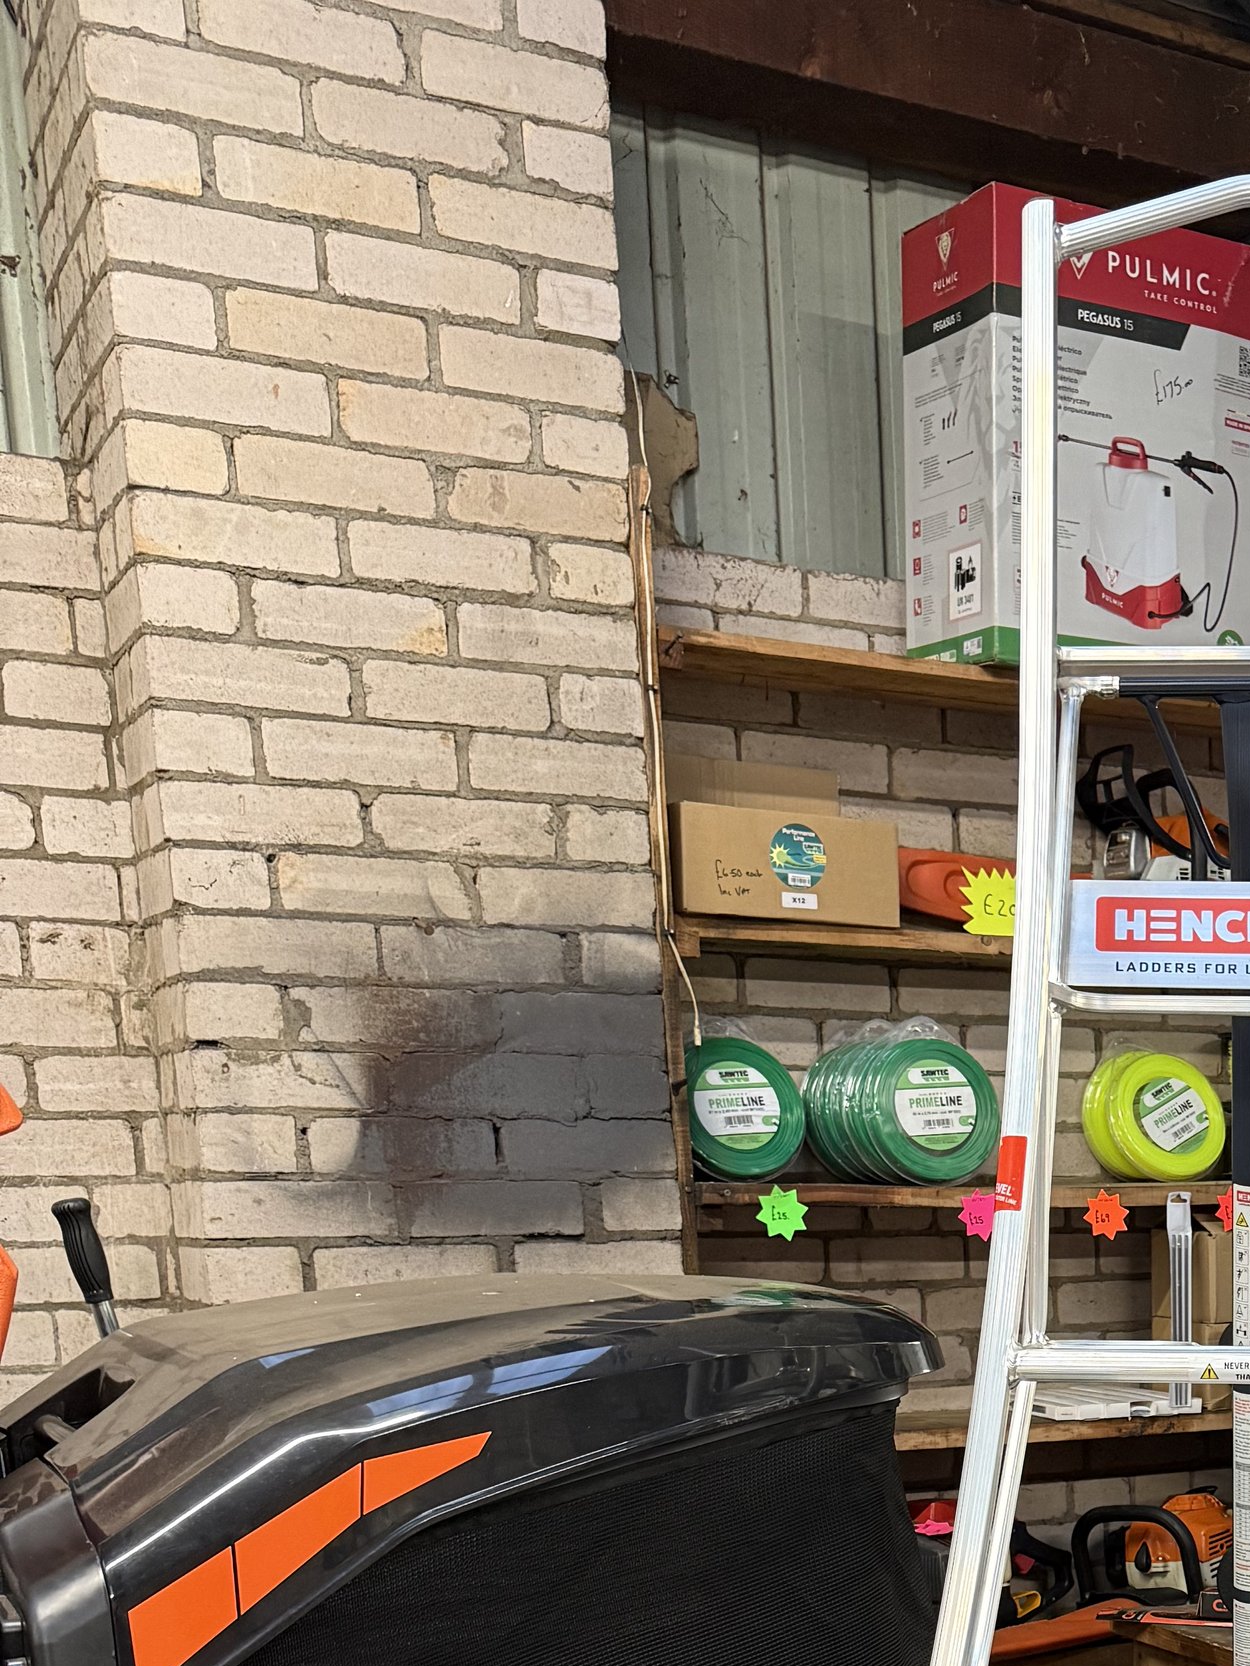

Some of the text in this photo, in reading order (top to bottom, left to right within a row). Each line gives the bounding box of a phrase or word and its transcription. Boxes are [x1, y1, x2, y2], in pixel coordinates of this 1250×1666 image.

[933, 271, 958, 292] PULMIC
[1107, 250, 1210, 296] PULMIC
[1144, 290, 1217, 314] TAKE CONTROL
[1077, 308, 1134, 331] PEGASUS 15
[1101, 592, 1124, 609] PULMIC
[1115, 960, 1196, 974] LADDERS
[1204, 962, 1238, 976] FOR
[920, 1068, 949, 1077] SAWTEC
[708, 1095, 766, 1110] PRIMELINE
[909, 1095, 963, 1109] PRIMELINE
[1153, 1099, 1194, 1129] PRIMELINE
[1224, 1362, 1249, 1370] NEVER
